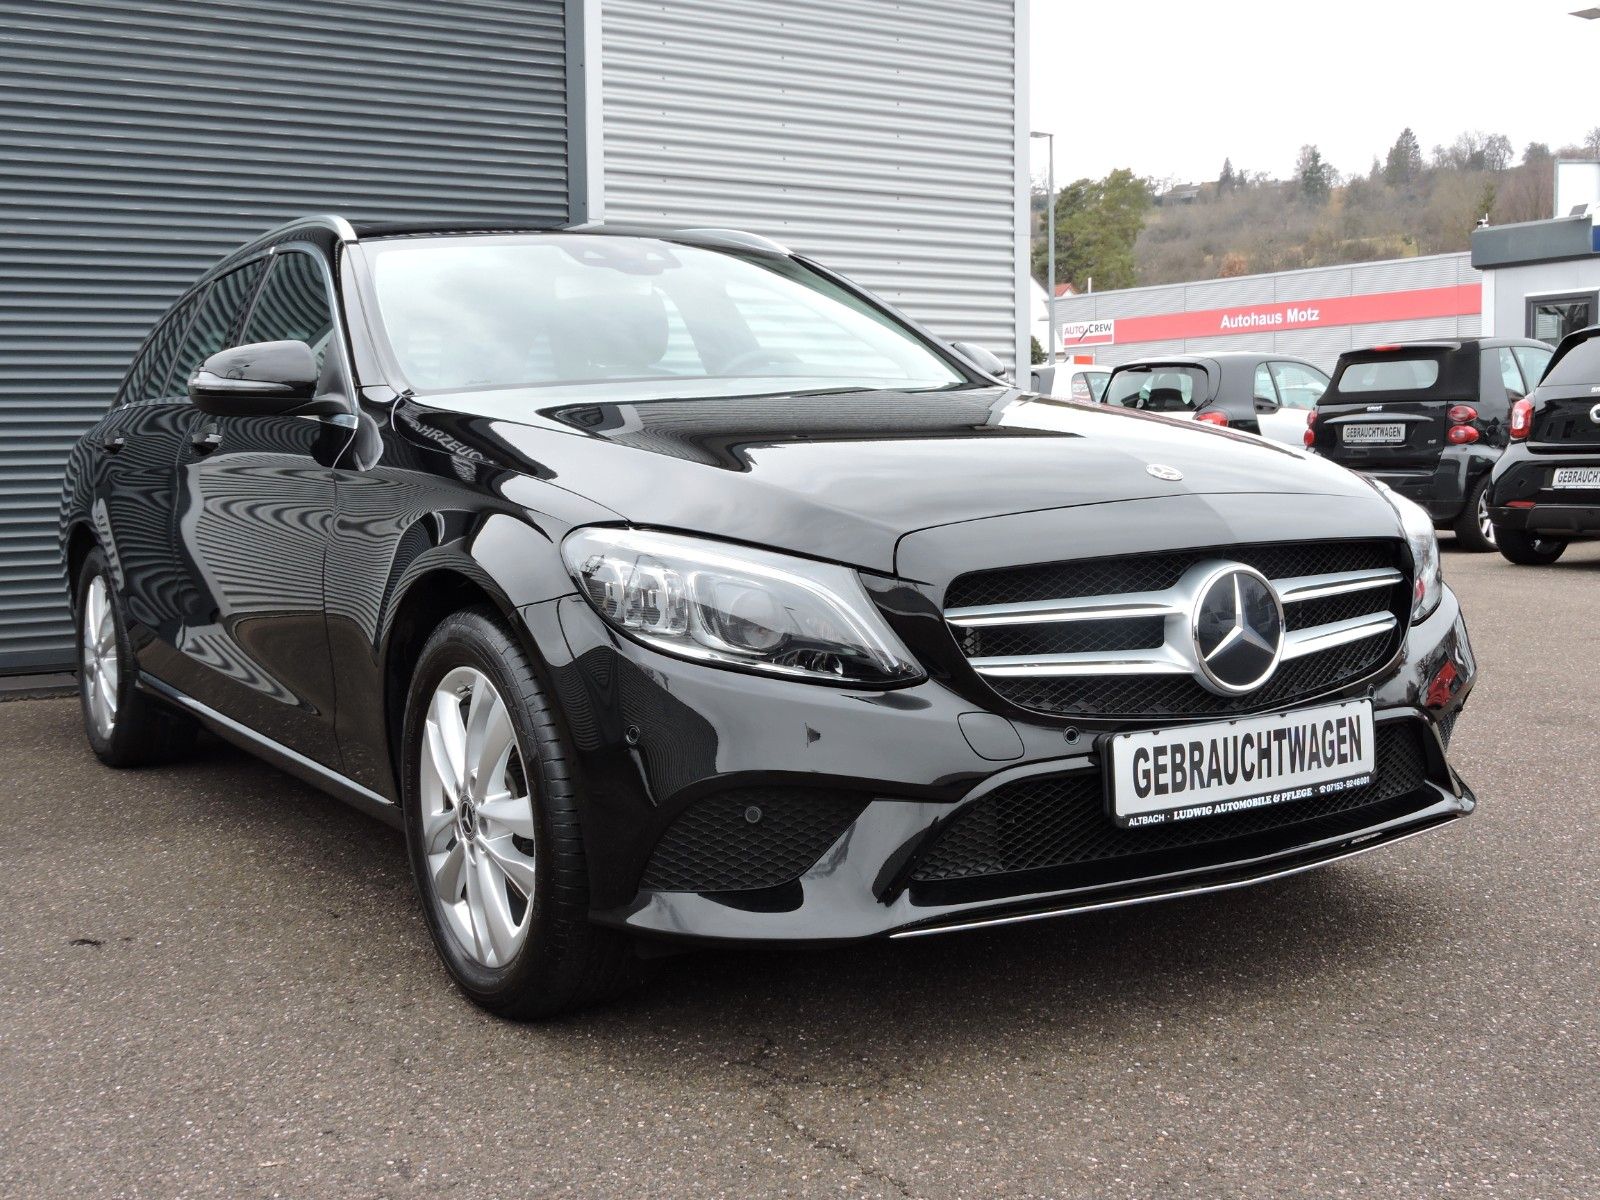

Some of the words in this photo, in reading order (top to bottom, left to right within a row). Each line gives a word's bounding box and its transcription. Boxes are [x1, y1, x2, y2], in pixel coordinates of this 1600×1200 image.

[1220, 312, 1283, 329] Autohaus
[1286, 307, 1320, 323] Motz
[1064, 325, 1085, 336] AUTO
[1088, 323, 1112, 334] CREW
[1346, 426, 1401, 438] GEBRAUCHTWAGEN
[1132, 714, 1362, 799] GEBRAUCHTWAGEN
[1128, 813, 1165, 827] ALTBACH
[1173, 805, 1213, 820] LUDWIG
[1213, 795, 1272, 814] AUTOMOBILE
[1272, 792, 1281, 803] &
[1281, 787, 1313, 802] PFLEGE
